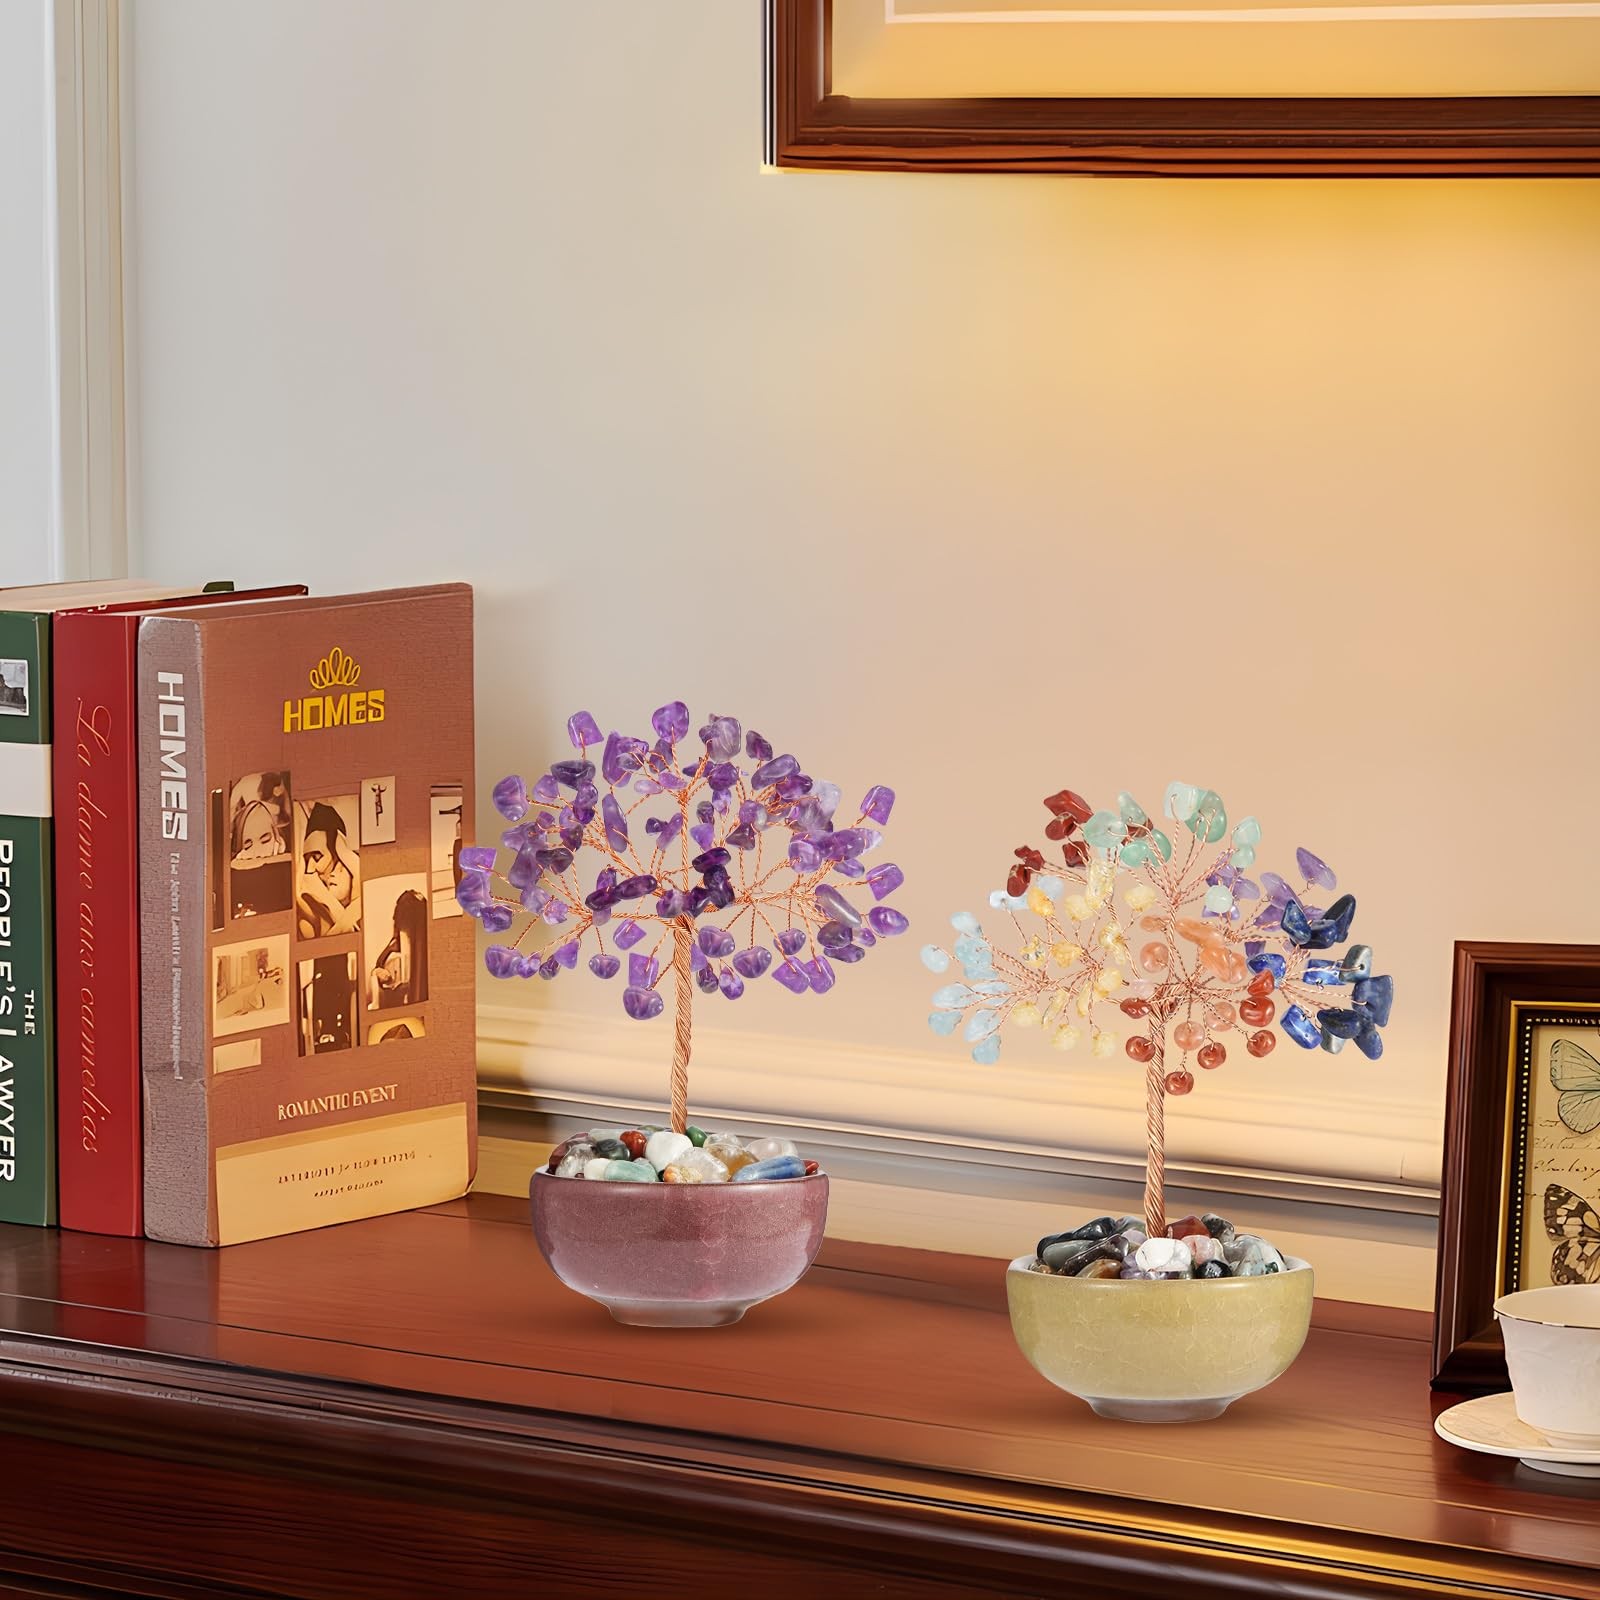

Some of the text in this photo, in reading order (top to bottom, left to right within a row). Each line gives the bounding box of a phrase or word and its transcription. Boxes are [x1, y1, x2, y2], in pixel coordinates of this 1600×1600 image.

[283, 689, 385, 733] HOMES
[157, 671, 188, 841] HOMES
[76, 697, 112, 1153] La dame aux camelias
[24, 989, 36, 1036] THE
[353, 1083, 398, 1107] EVENT
